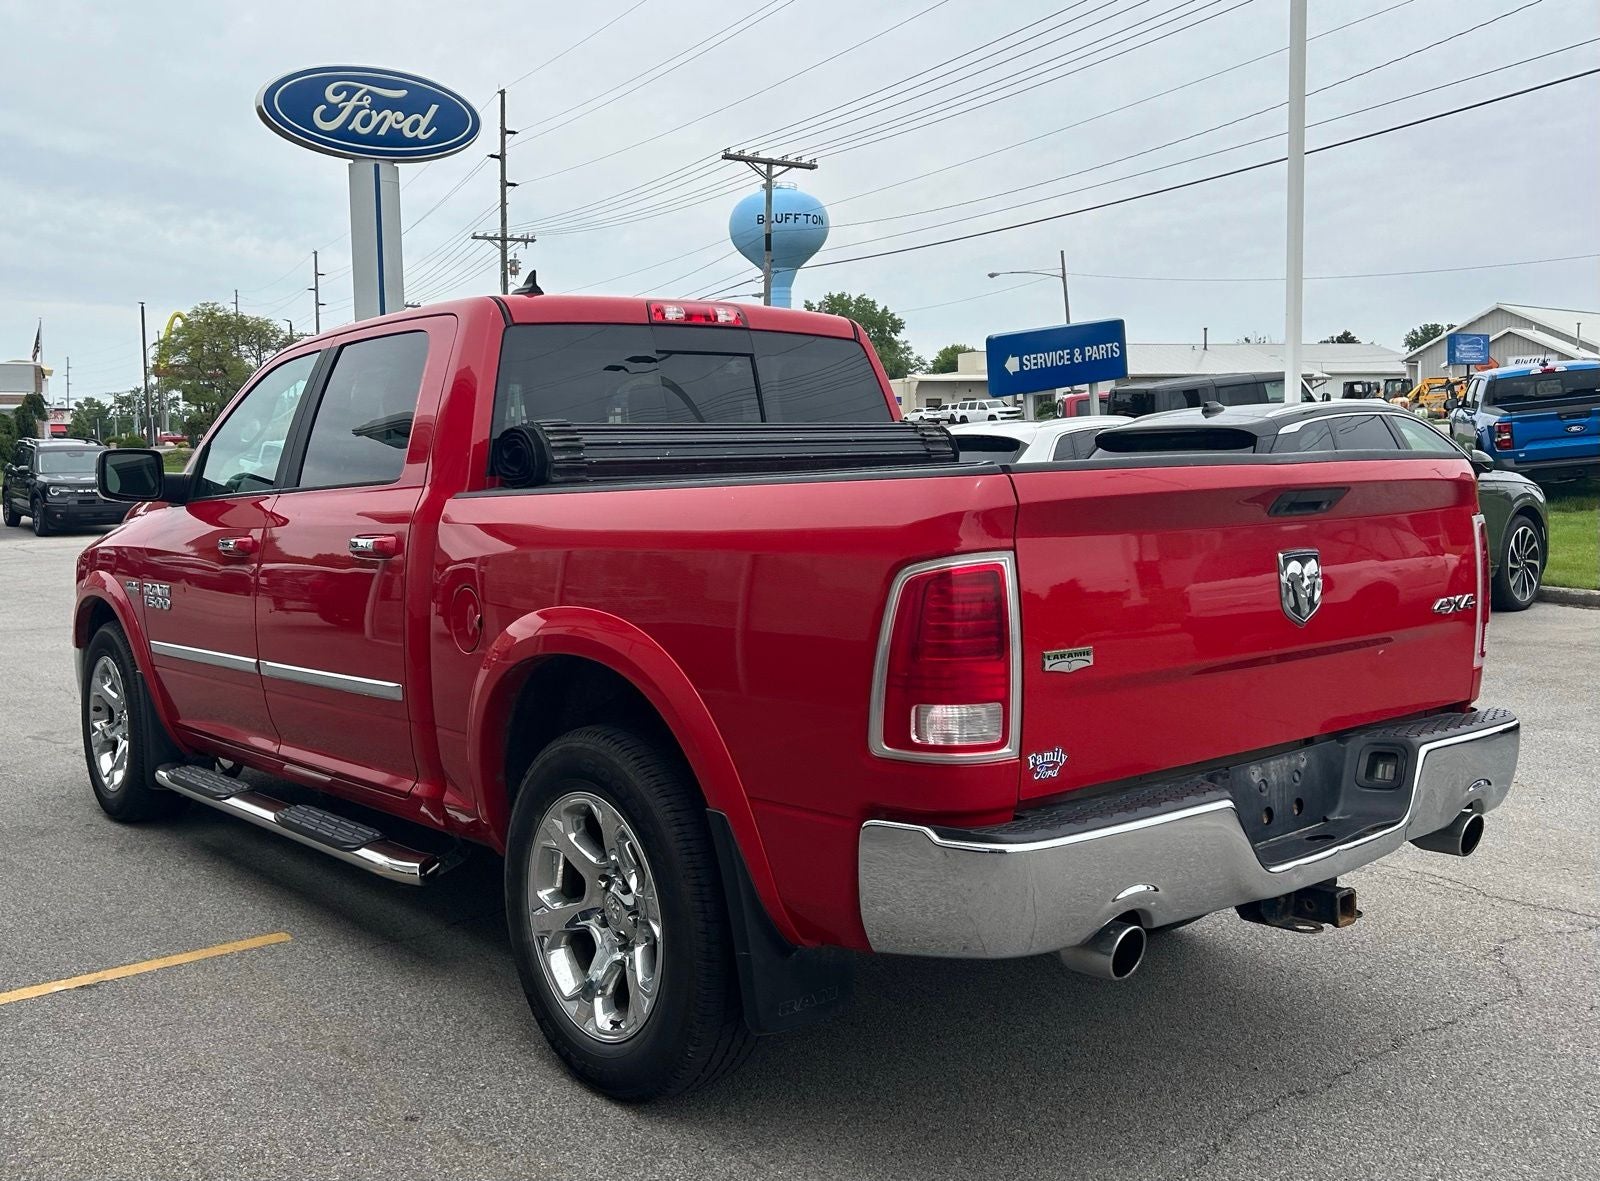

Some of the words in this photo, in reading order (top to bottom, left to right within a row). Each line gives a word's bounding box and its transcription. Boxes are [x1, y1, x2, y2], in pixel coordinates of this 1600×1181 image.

[312, 81, 440, 140] Ford
[1022, 349, 1071, 371] SERVICE
[1073, 348, 1083, 364] &
[1085, 342, 1120, 362] PARTS
[143, 582, 171, 597] RAM
[144, 595, 171, 610] 1500
[1046, 650, 1092, 661] LARAMIE
[1027, 747, 1068, 770] Family
[1033, 763, 1060, 780] Ford
